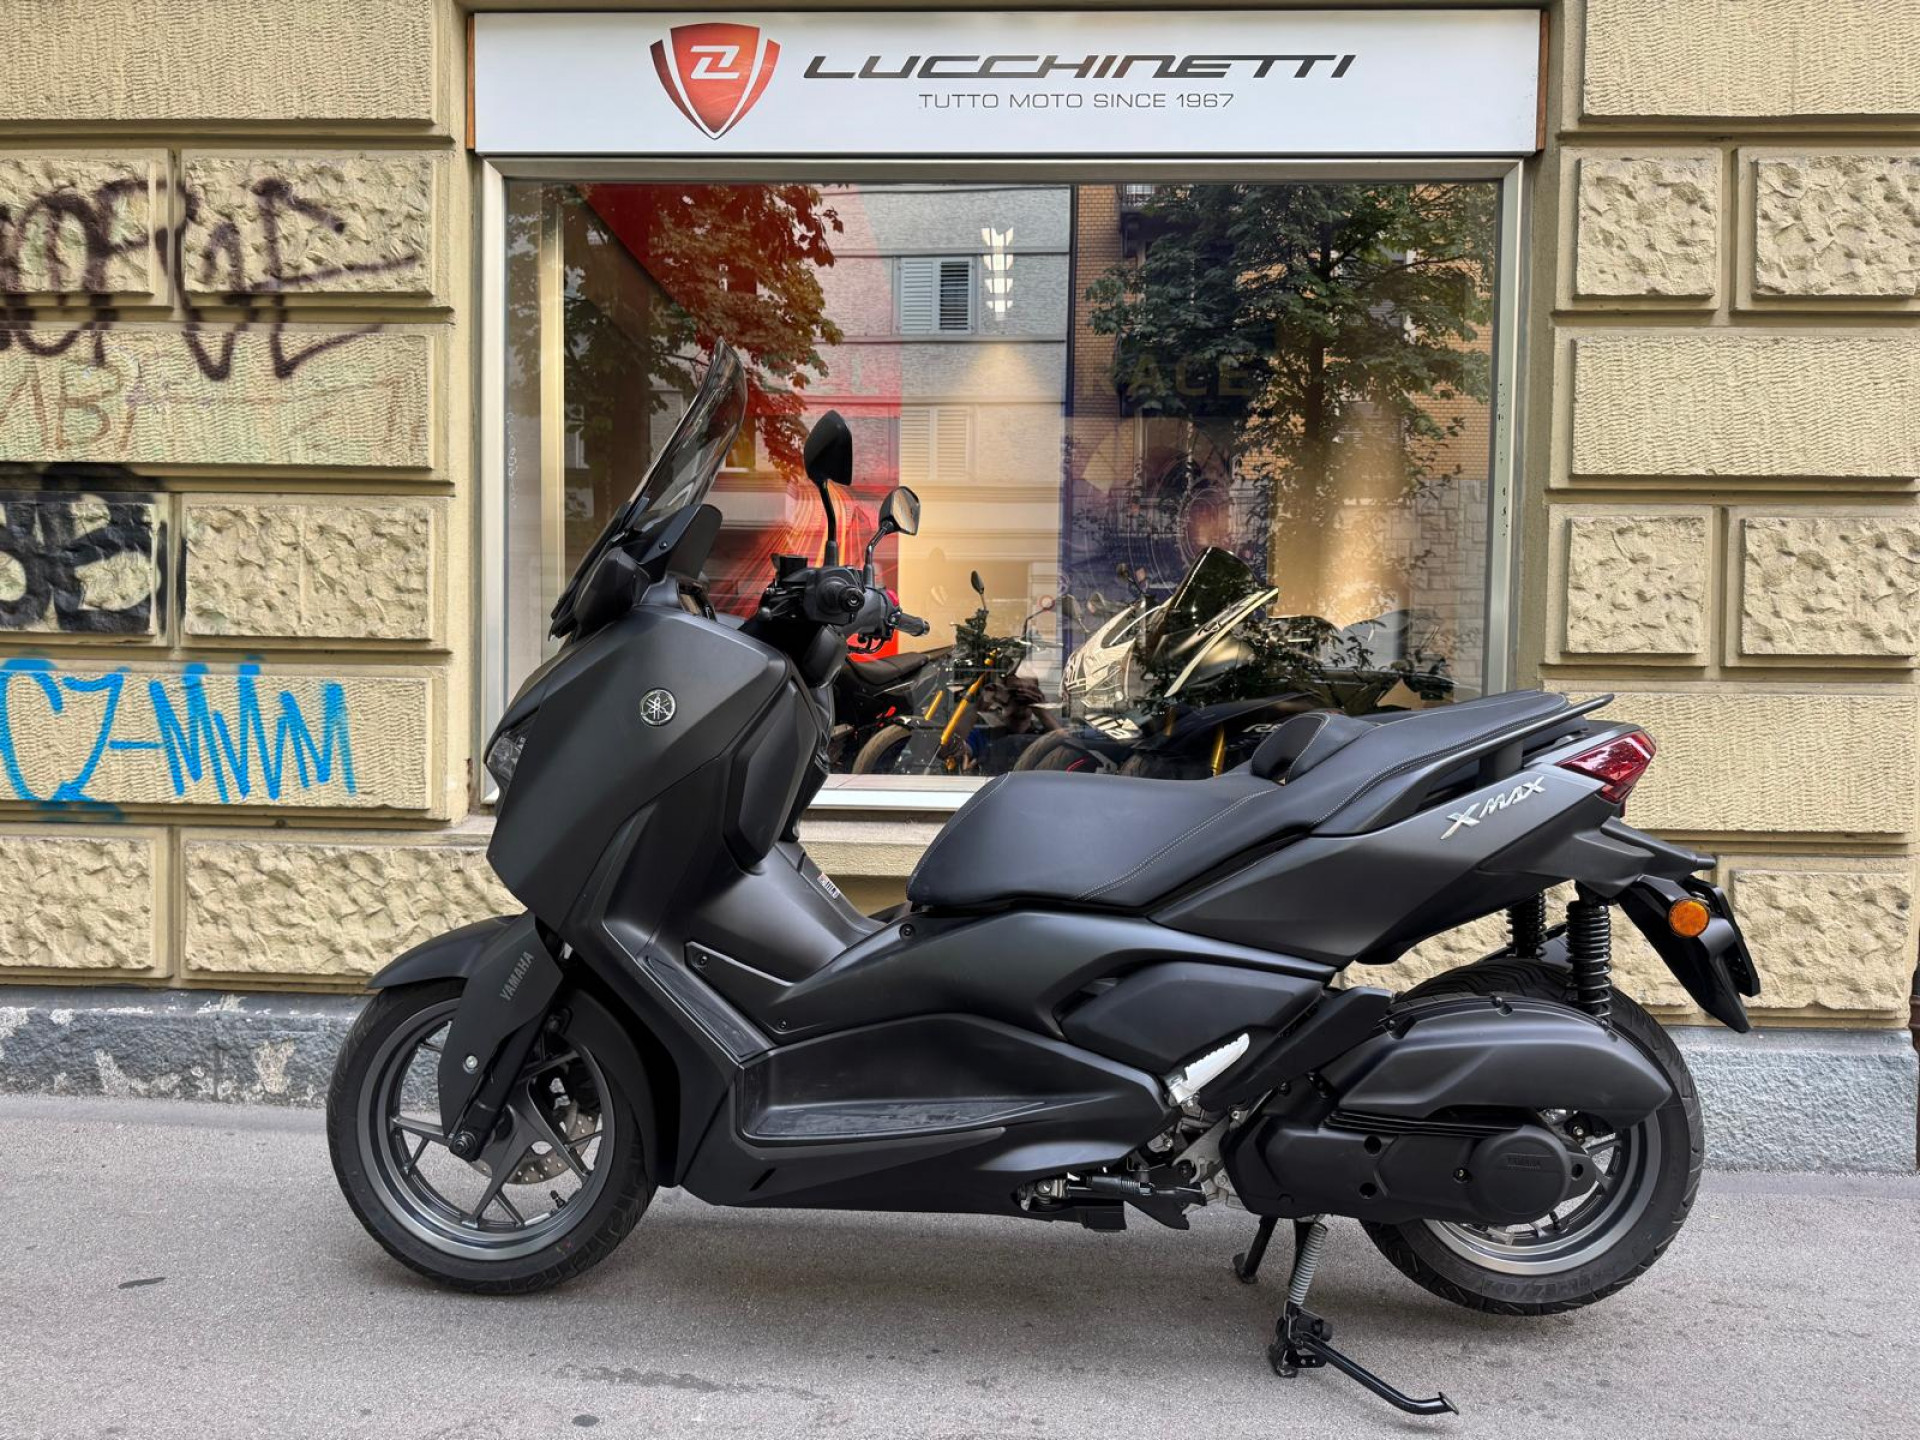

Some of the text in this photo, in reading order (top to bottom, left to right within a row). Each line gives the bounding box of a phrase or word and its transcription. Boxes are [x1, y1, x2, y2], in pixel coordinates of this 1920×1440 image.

[803, 55, 1357, 79] LUCCHINETTI
[919, 93, 1234, 108] TUTTO MOTO SINCE 1967
[500, 951, 535, 1001] YAMAHA
